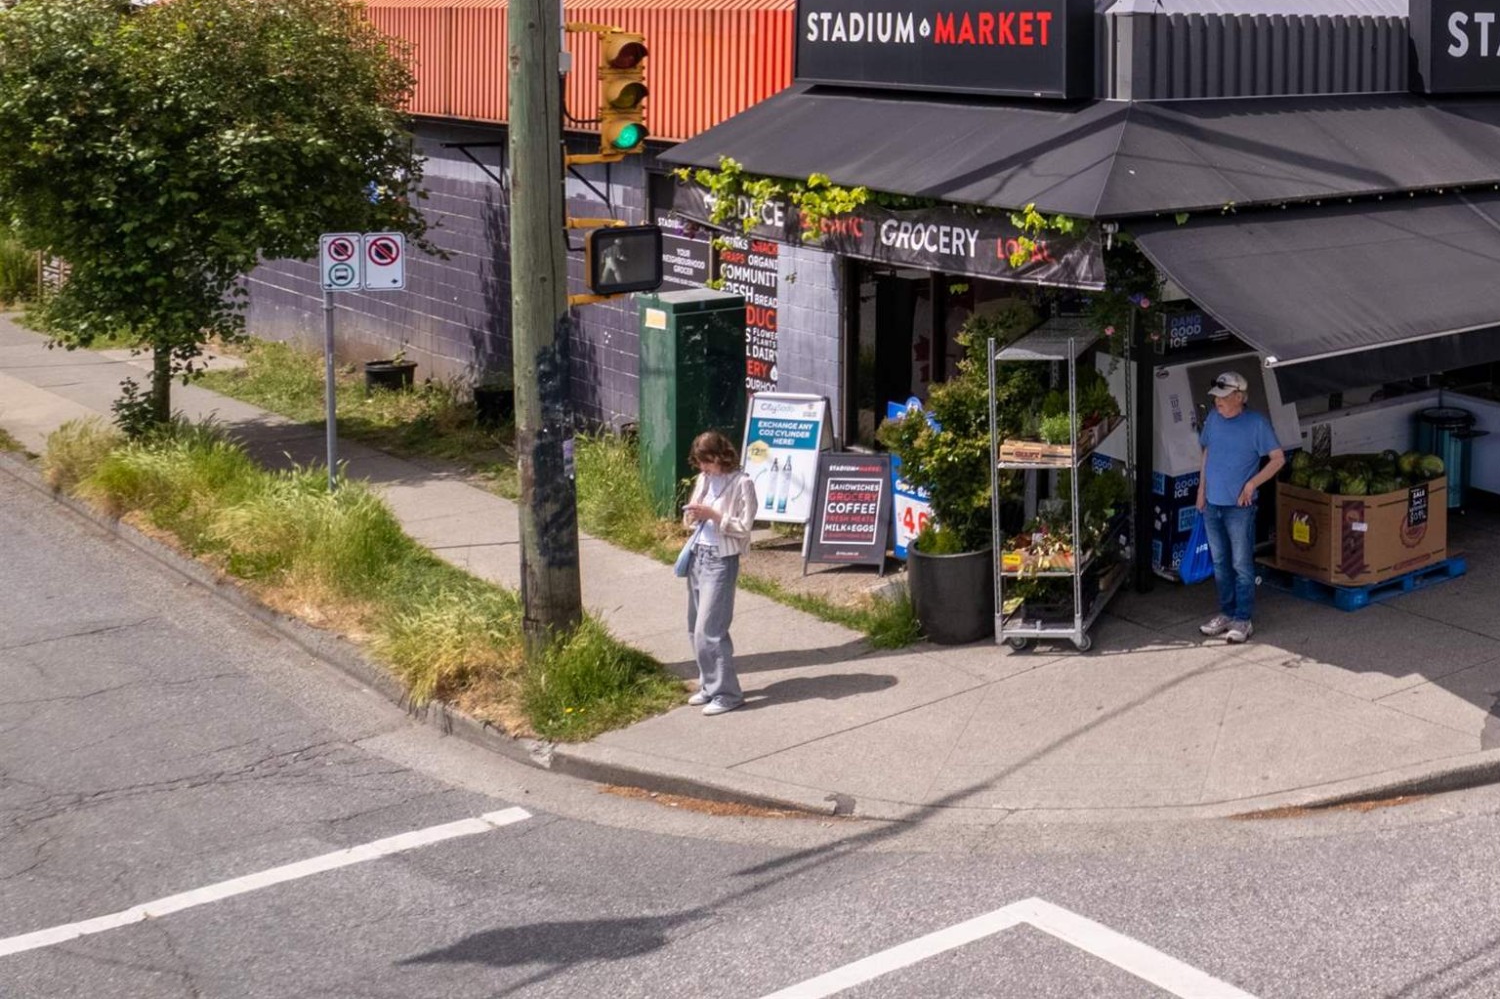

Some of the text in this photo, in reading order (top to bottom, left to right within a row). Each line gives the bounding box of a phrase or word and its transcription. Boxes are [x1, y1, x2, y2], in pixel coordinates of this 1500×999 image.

[806, 12, 1052, 46] STADIUM MARKET
[880, 218, 979, 258] GROCERY
[720, 263, 778, 287] COMMUNIT
[1170, 324, 1201, 338] GOOD
[1170, 336, 1188, 348] ICE
[758, 421, 813, 431] EXCHANGE ANY
[775, 430, 810, 438] CYLINDER
[829, 492, 878, 502] GROCERY
[1174, 487, 1189, 499] ICE
[827, 503, 876, 514] COFFEE
